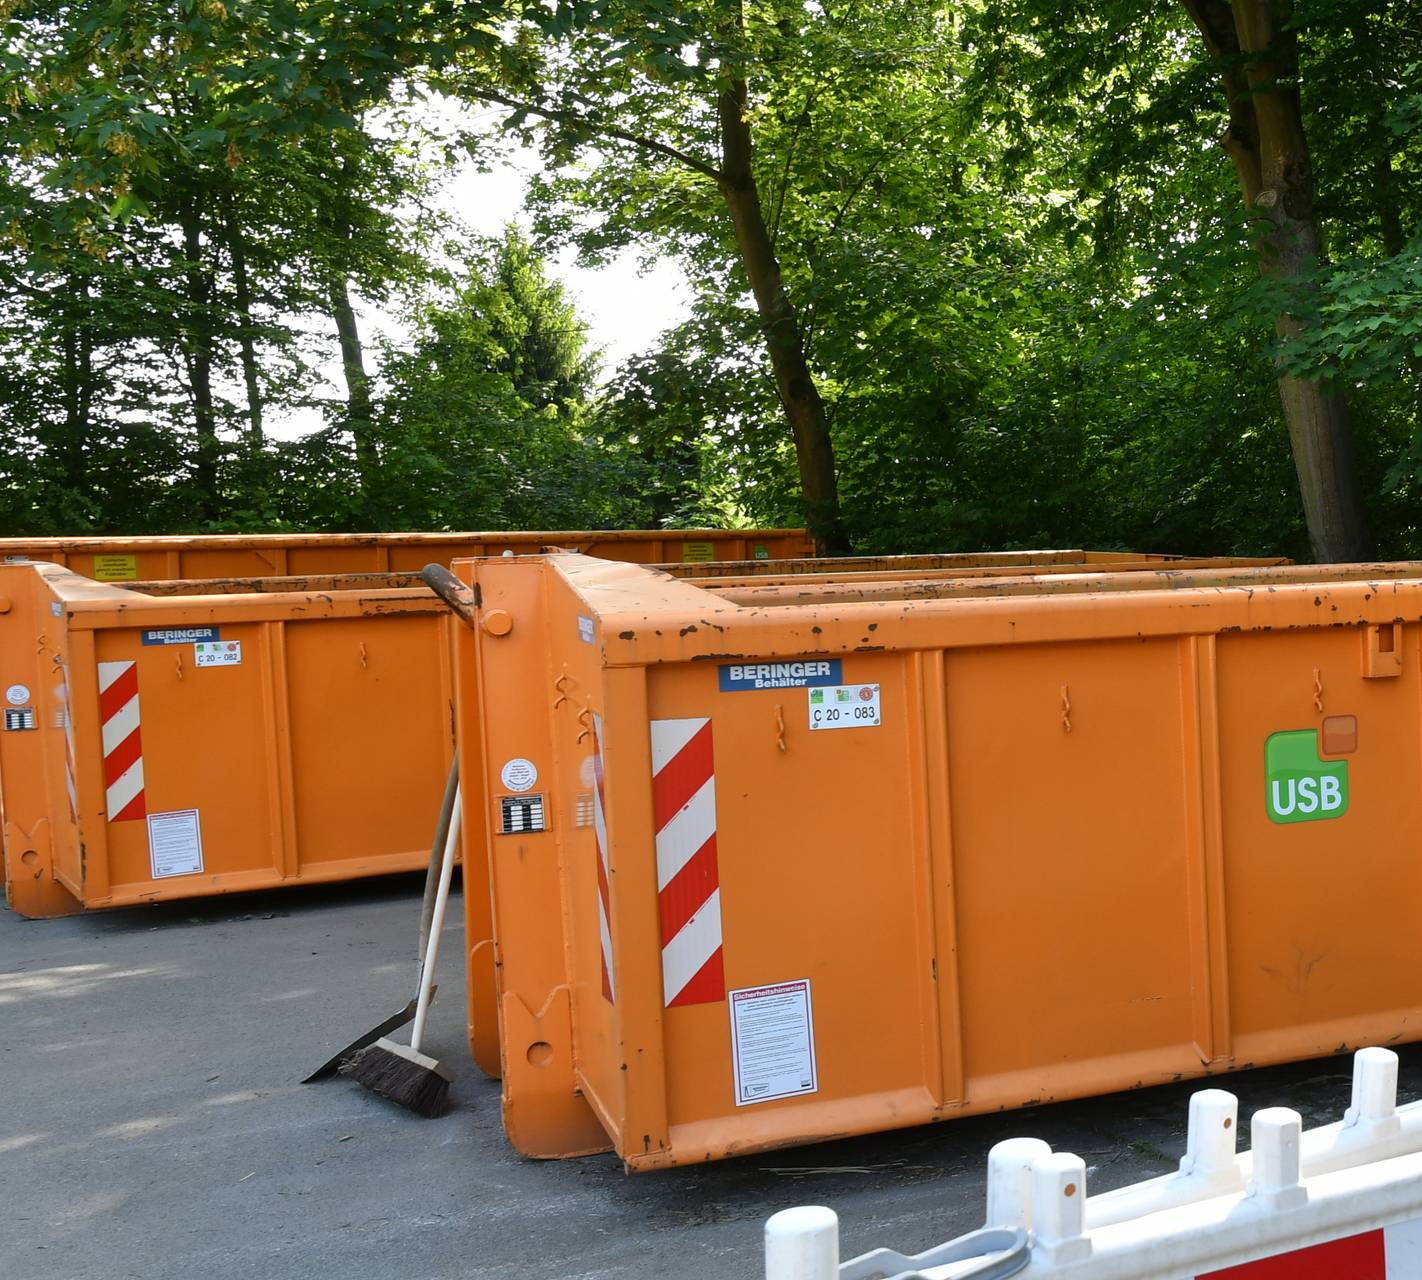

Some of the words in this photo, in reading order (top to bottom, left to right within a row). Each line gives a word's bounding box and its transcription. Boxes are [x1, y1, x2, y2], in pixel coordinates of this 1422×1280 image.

[148, 628, 212, 639] BERINGER
[224, 653, 238, 661] 082
[730, 662, 830, 681] BERINGER
[755, 678, 807, 688] Behälter
[814, 709, 822, 722] C
[826, 708, 840, 721] 20
[854, 706, 875, 719] 083
[1272, 775, 1342, 816] USB
[734, 984, 806, 1000] Sicherheitshinweise
